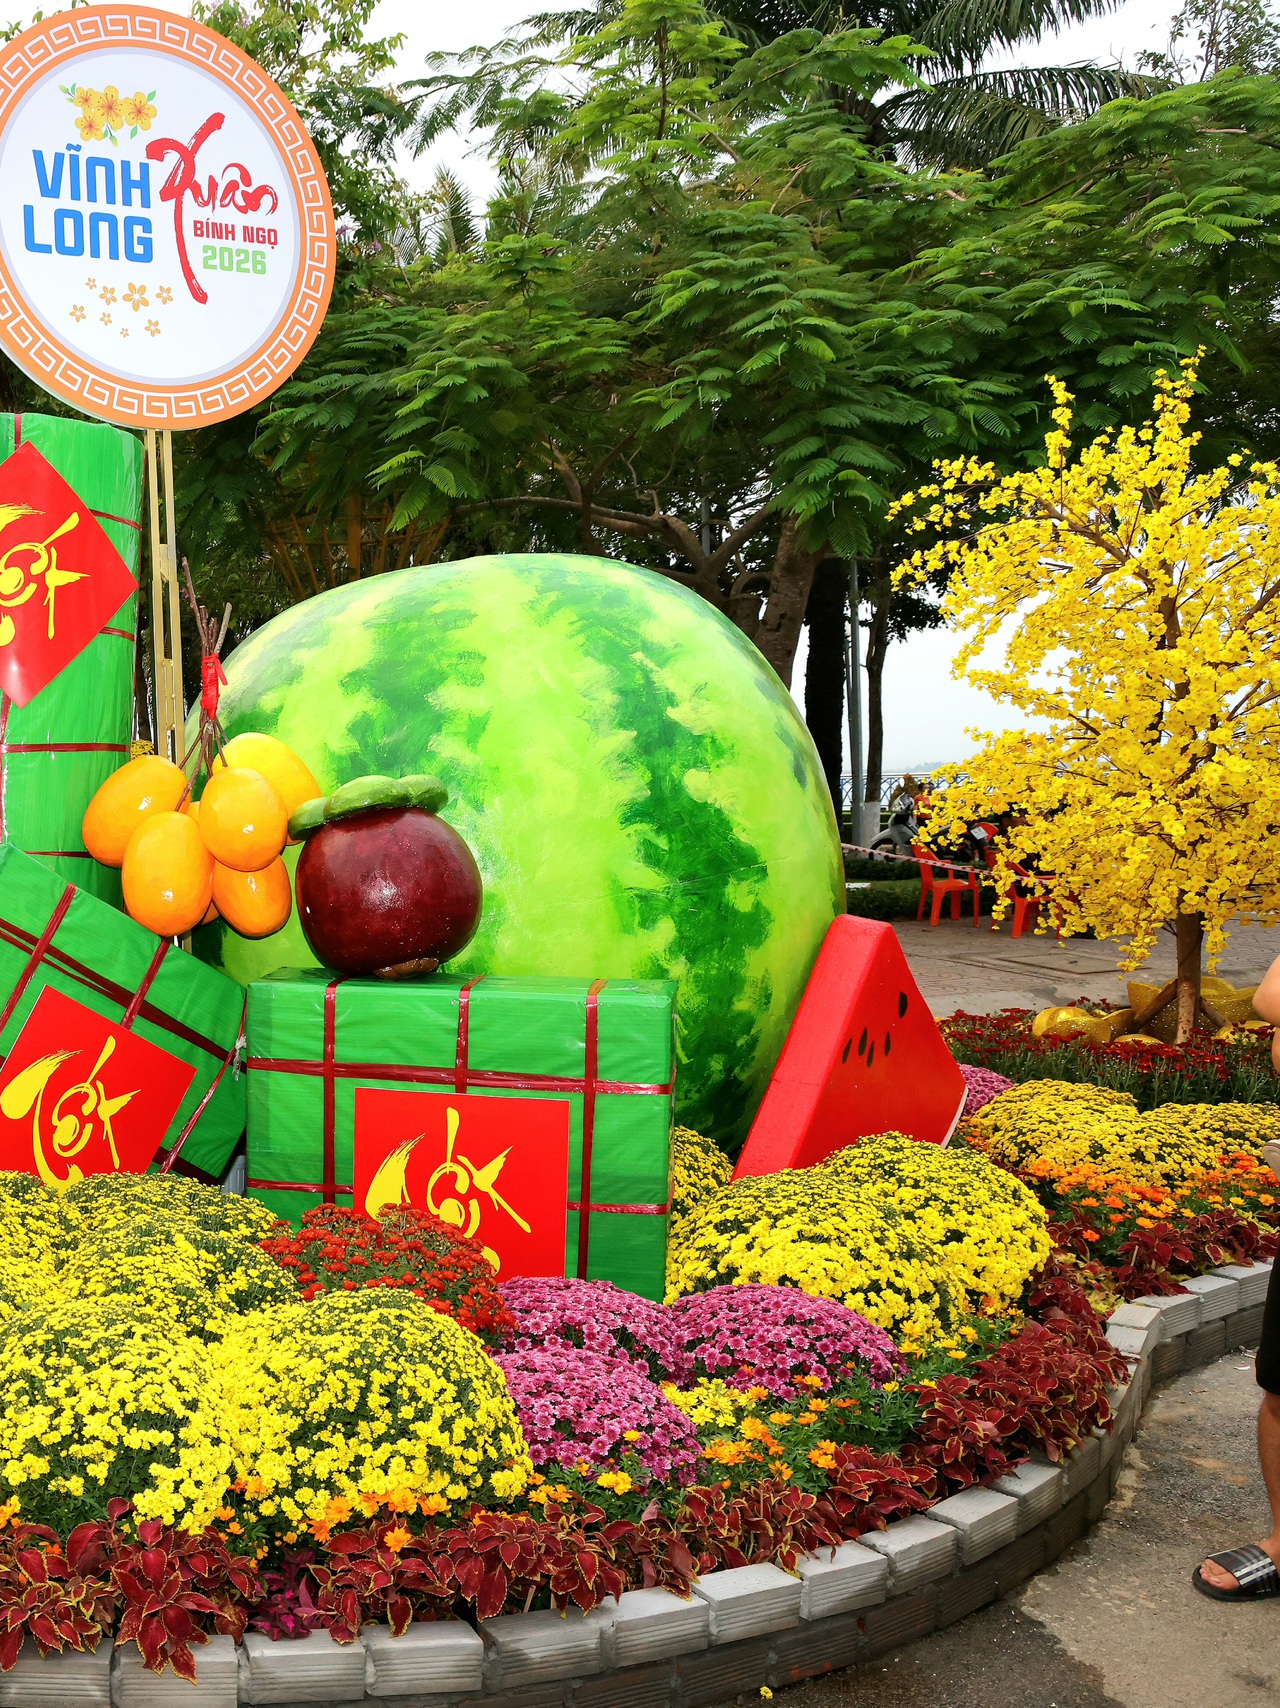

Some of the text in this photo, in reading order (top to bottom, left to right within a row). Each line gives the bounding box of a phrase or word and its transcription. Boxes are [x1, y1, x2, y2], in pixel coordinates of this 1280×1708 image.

[32, 143, 151, 209] VĨNH
[23, 204, 154, 263] LONG
[145, 112, 279, 305] Xuân
[193, 220, 278, 250] BÍNH NGỌ
[202, 245, 267, 275] 2026
[0, 1035, 141, 1198] Tết
